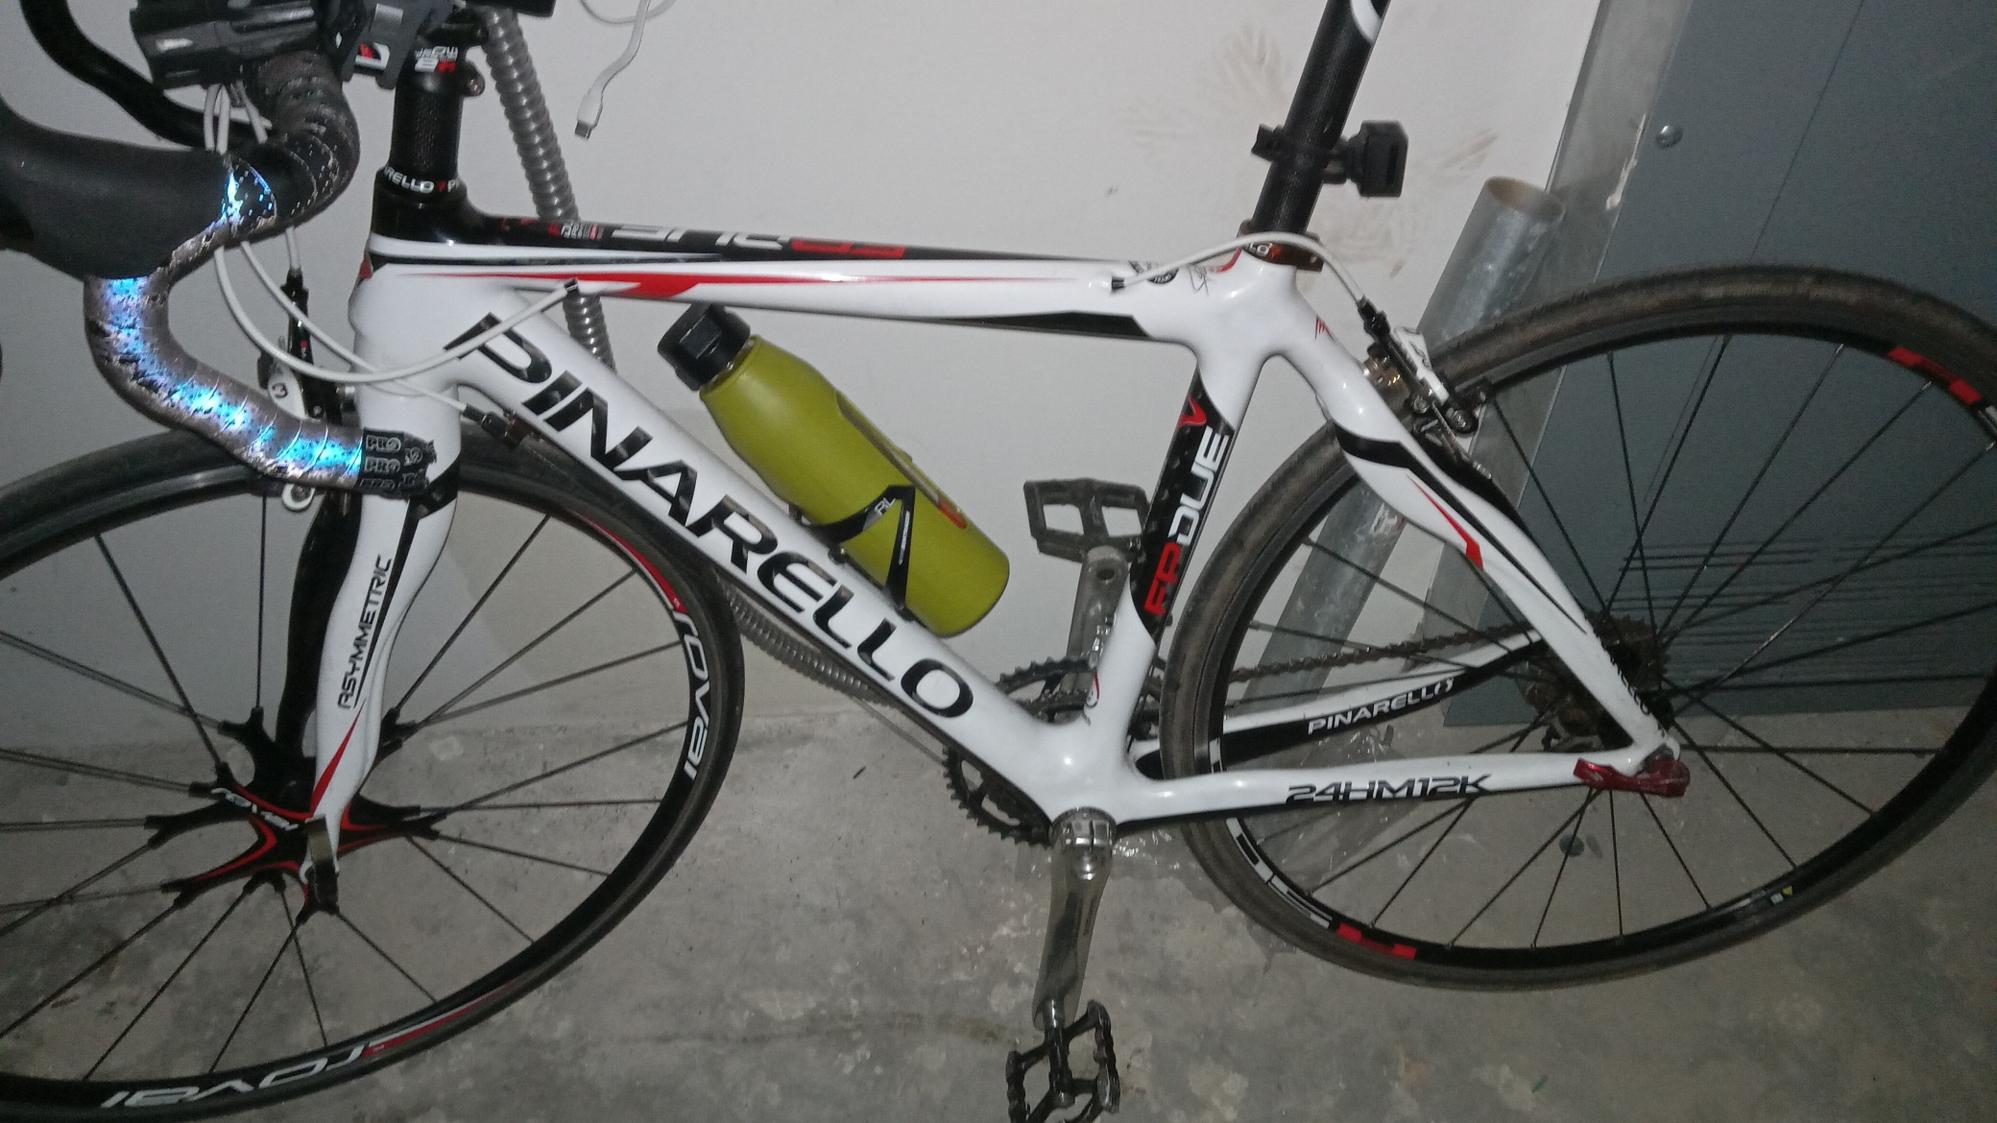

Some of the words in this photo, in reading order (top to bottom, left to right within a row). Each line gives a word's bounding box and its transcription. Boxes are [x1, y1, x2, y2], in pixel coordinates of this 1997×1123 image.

[443, 312, 974, 719] PINARELLO
[1307, 677, 1455, 736] PINARELLO
[1286, 773, 1492, 804] 24HM12K
